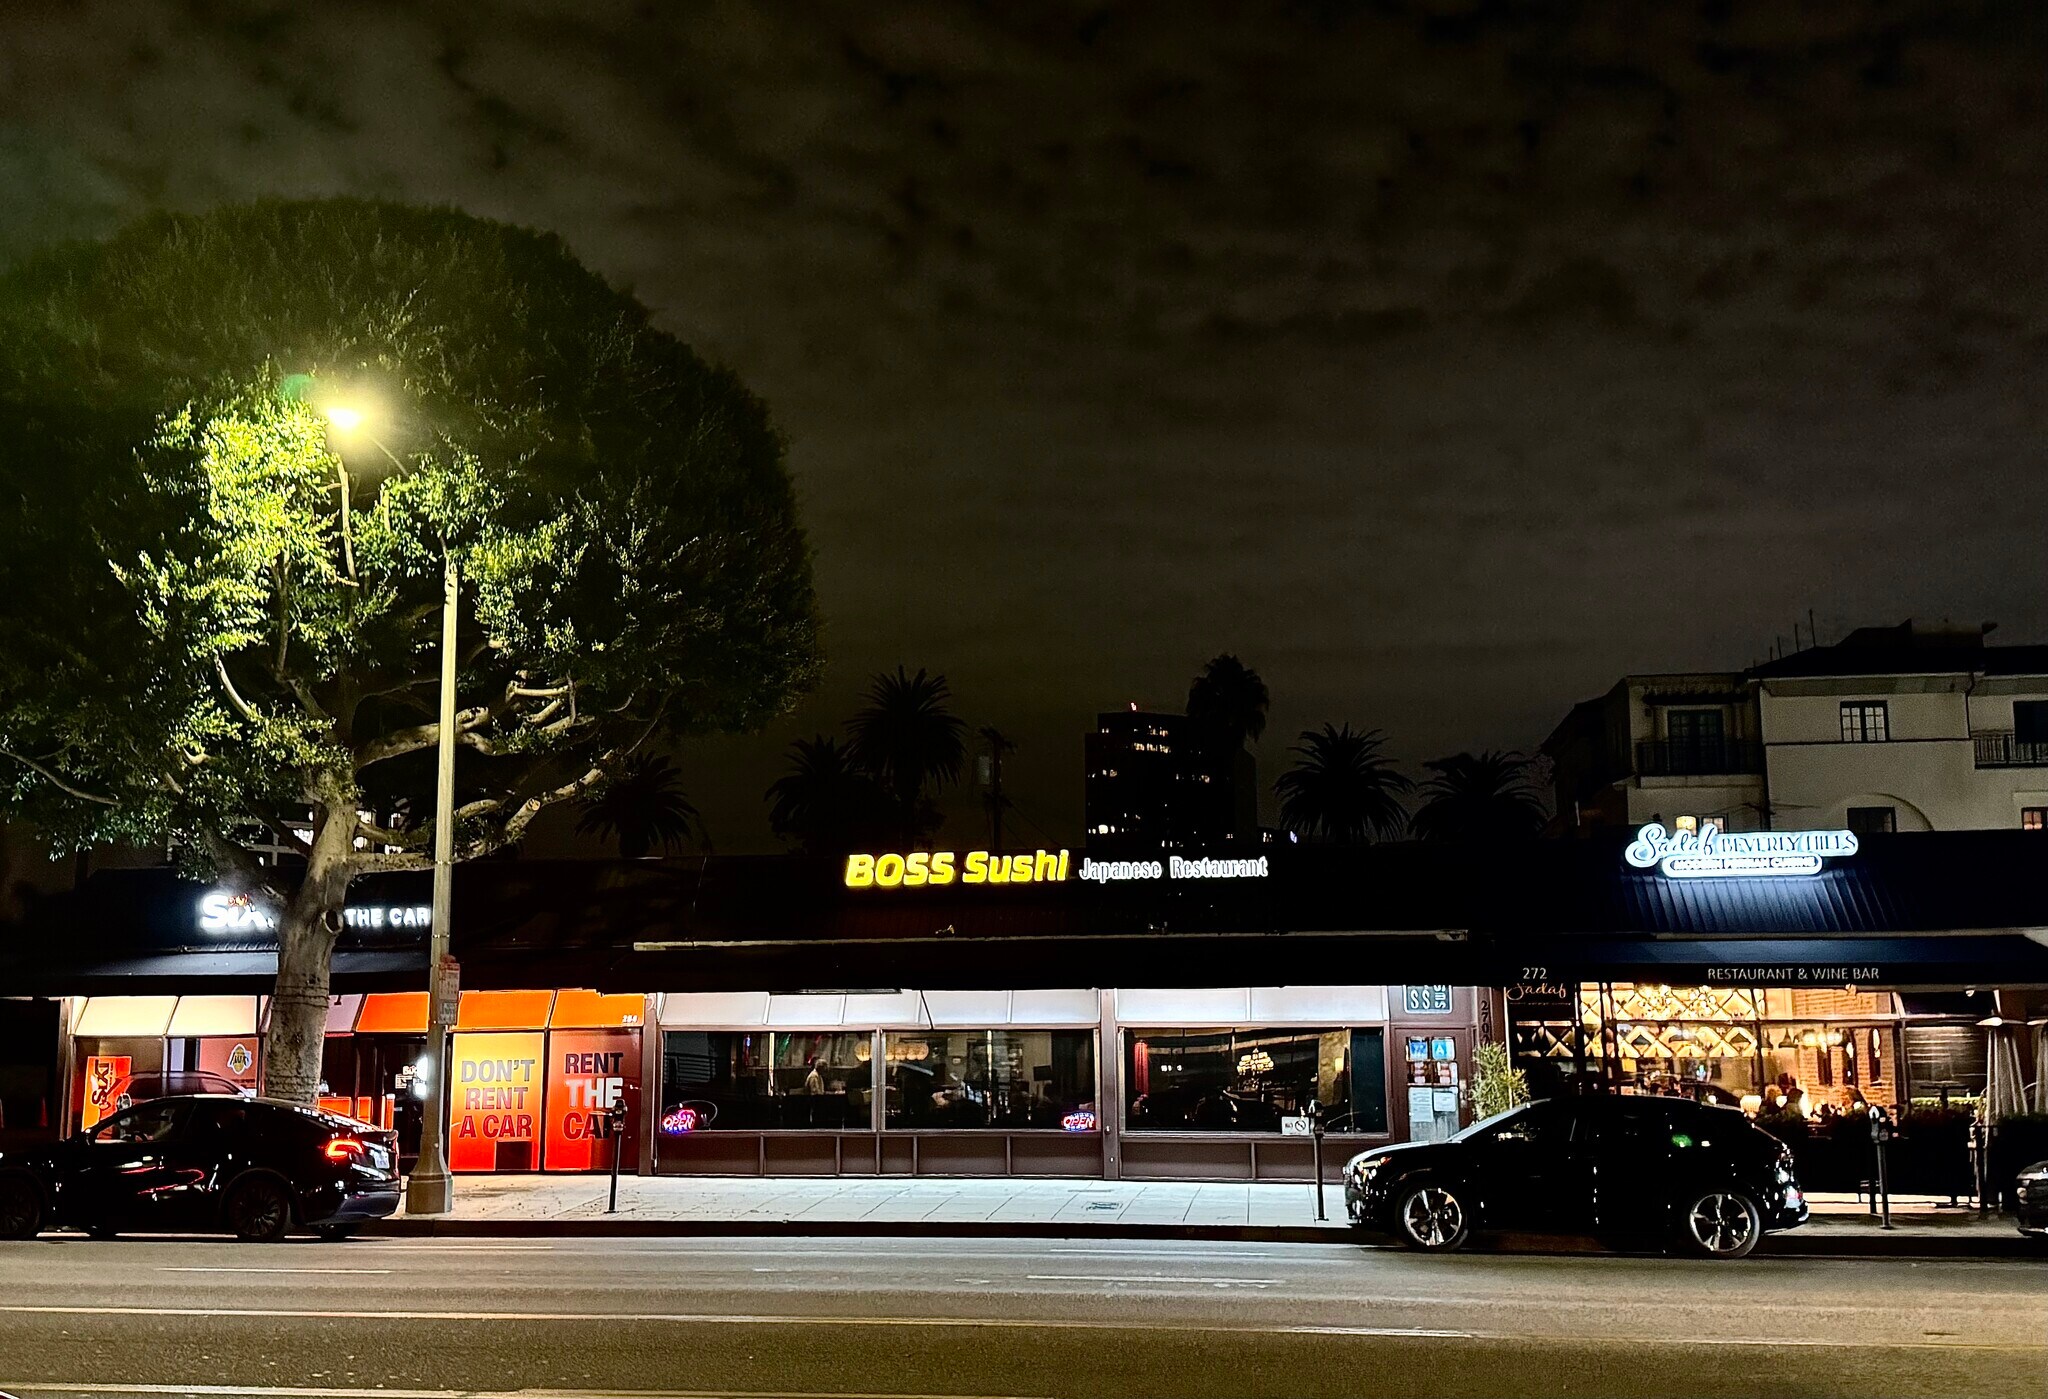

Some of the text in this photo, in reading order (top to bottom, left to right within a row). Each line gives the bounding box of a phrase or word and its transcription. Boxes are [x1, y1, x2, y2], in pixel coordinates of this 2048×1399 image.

[1721, 836, 1801, 854] BEVERLY
[845, 849, 1268, 887] BOSS Sushi Japanese Restaurant
[344, 907, 431, 926] THE CAR
[1522, 967, 1548, 980] 272
[1707, 968, 1880, 980] RESTAURANT & WINE BAR
[461, 1059, 535, 1083] DON'T
[564, 1053, 624, 1075] RENT
[465, 1087, 529, 1110] RENT
[565, 1077, 624, 1109] THE
[458, 1115, 532, 1139] A CAR
[663, 1112, 696, 1132] OPEN
[1062, 1113, 1096, 1131] OPEN
